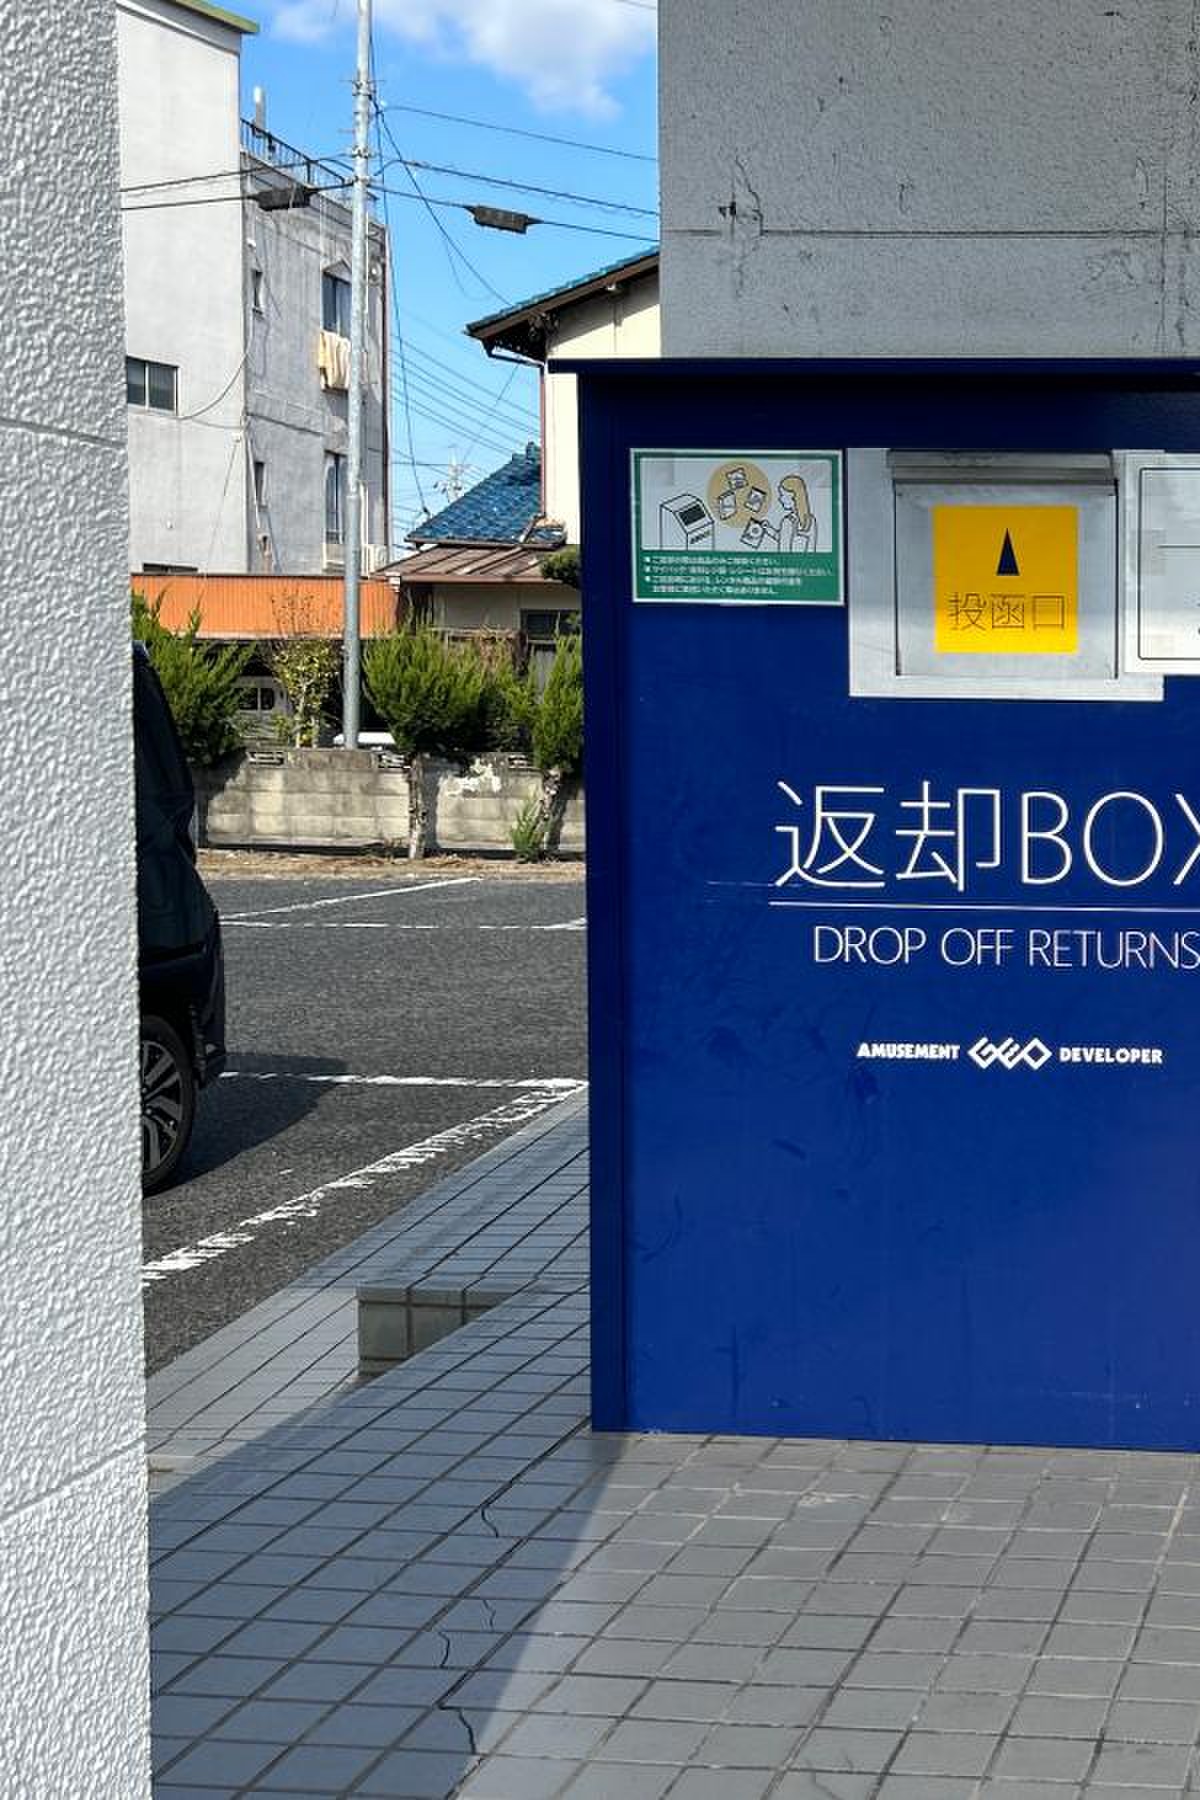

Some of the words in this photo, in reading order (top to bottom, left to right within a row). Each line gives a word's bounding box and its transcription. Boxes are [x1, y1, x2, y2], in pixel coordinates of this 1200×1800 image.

[949, 591, 1066, 632] 投函口
[814, 925, 927, 965] DROP
[940, 927, 1015, 966] OFF
[856, 1042, 961, 1062] AMUSEMENT
[1059, 1046, 1164, 1066] DEVELOPER
